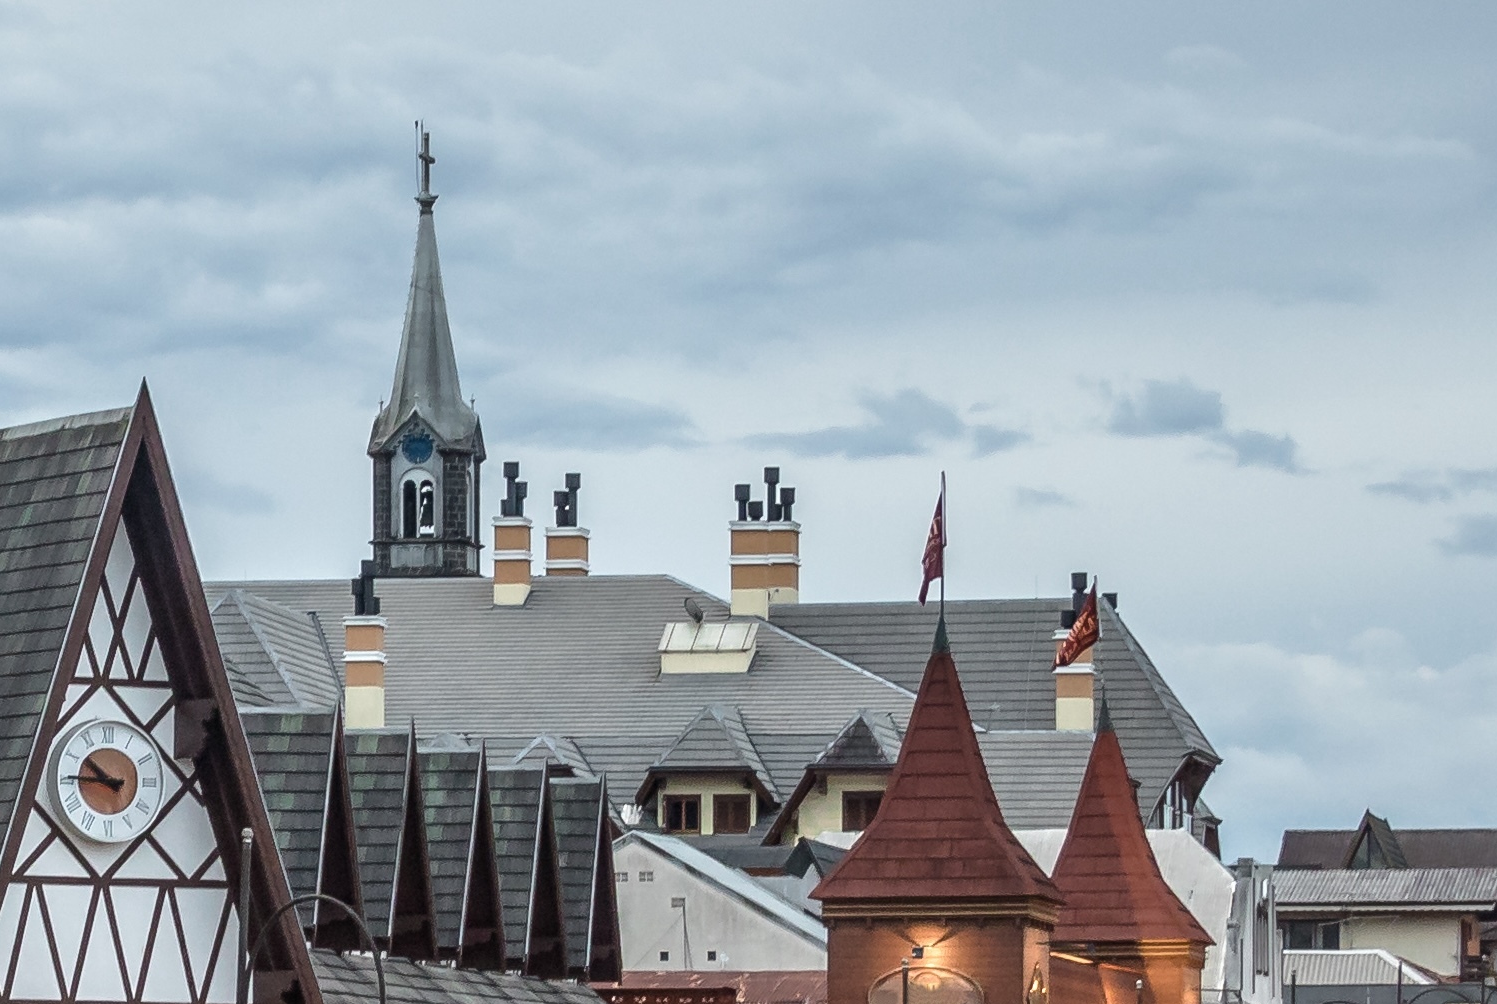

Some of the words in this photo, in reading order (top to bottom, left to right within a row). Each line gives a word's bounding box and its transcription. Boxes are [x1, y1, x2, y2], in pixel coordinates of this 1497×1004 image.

[80, 730, 95, 750] XI
[101, 726, 115, 744] XII
[125, 735, 134, 749] I
[137, 752, 153, 766] II
[141, 777, 157, 788] III
[64, 791, 82, 815] VIII
[80, 810, 96, 832] VII
[103, 820, 113, 838] VI
[122, 813, 133, 831] V
